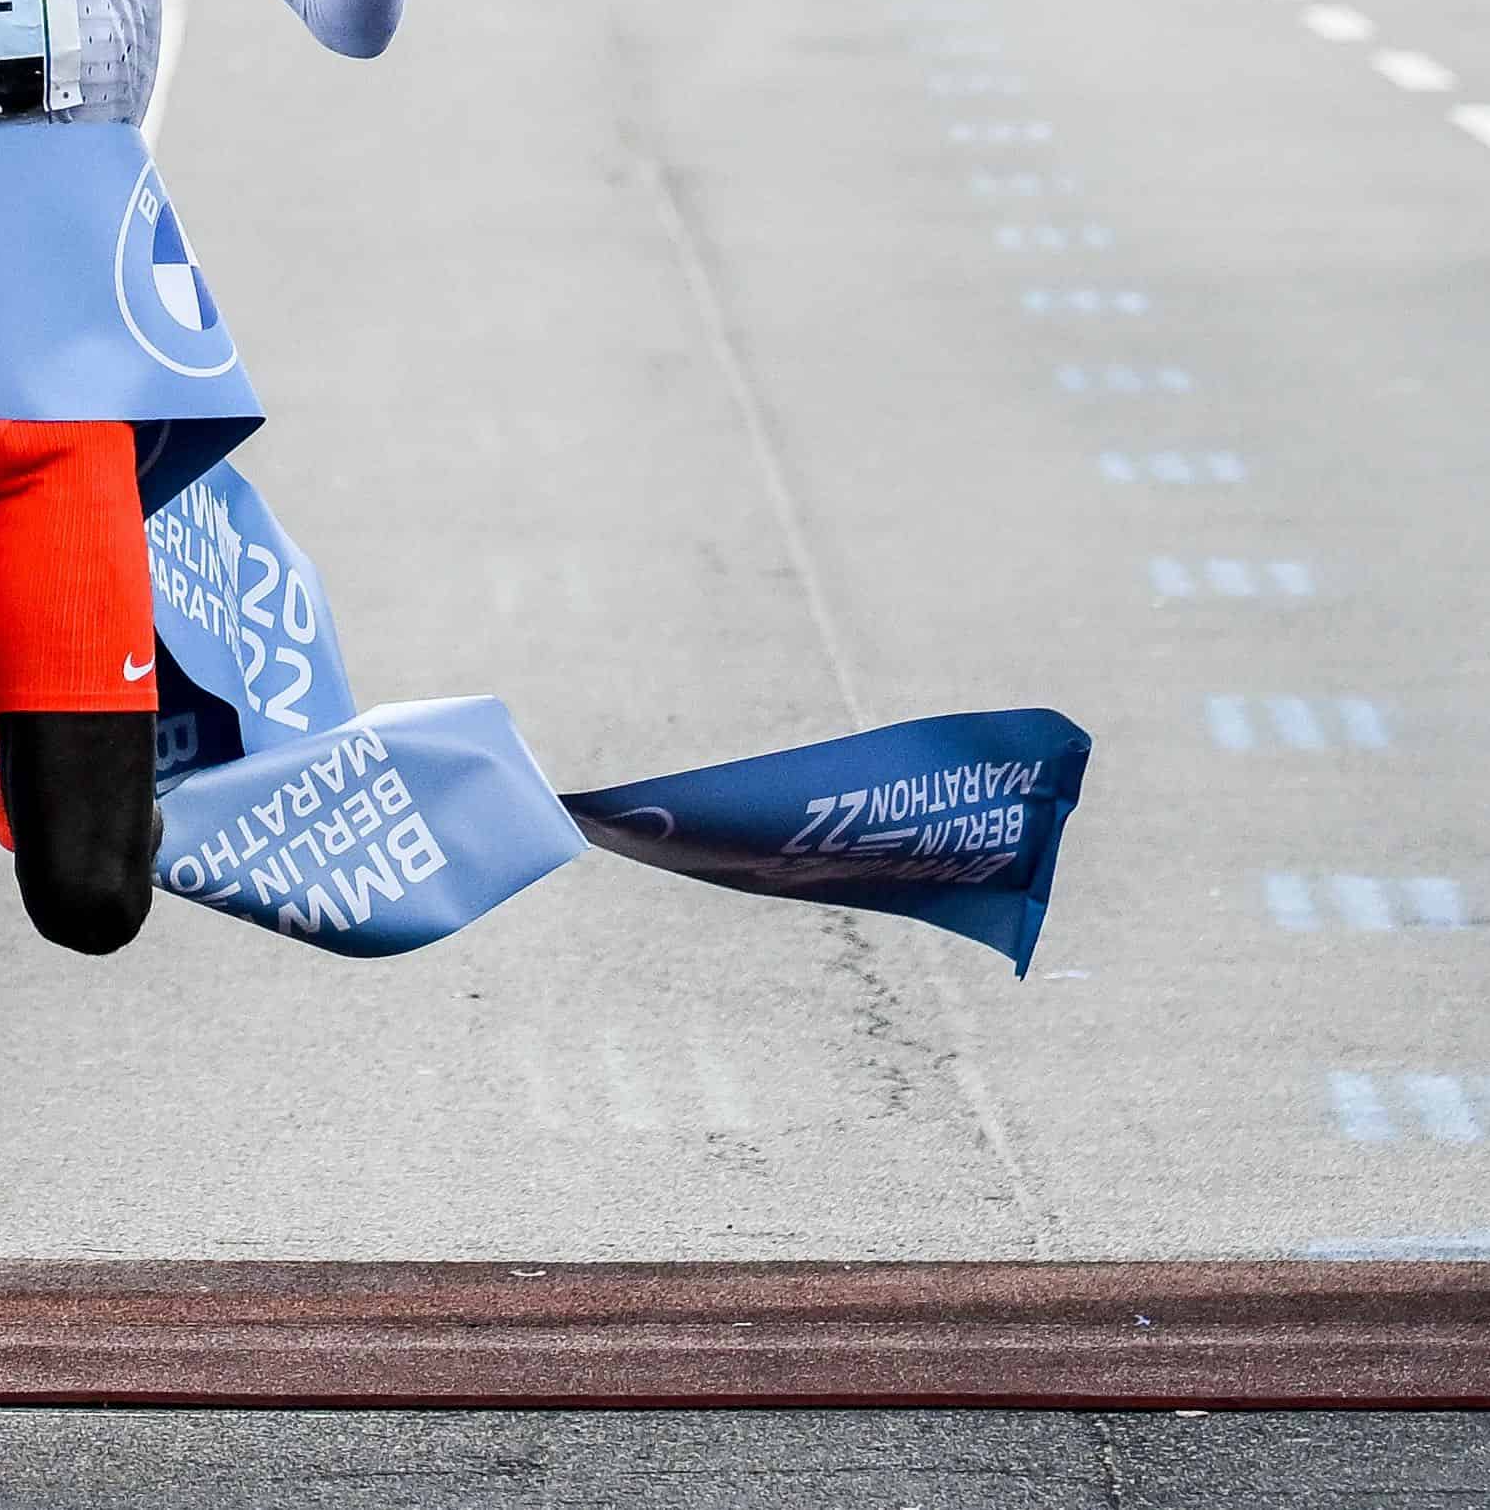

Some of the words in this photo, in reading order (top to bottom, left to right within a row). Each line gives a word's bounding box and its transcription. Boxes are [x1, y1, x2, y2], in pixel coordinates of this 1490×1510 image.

[144, 508, 224, 592] ERLIN
[241, 543, 317, 645] 20
[242, 627, 313, 732] 22
[249, 767, 414, 906] BERLIN
[866, 761, 1044, 825] MARATHON
[912, 803, 1025, 857] BERLIN
